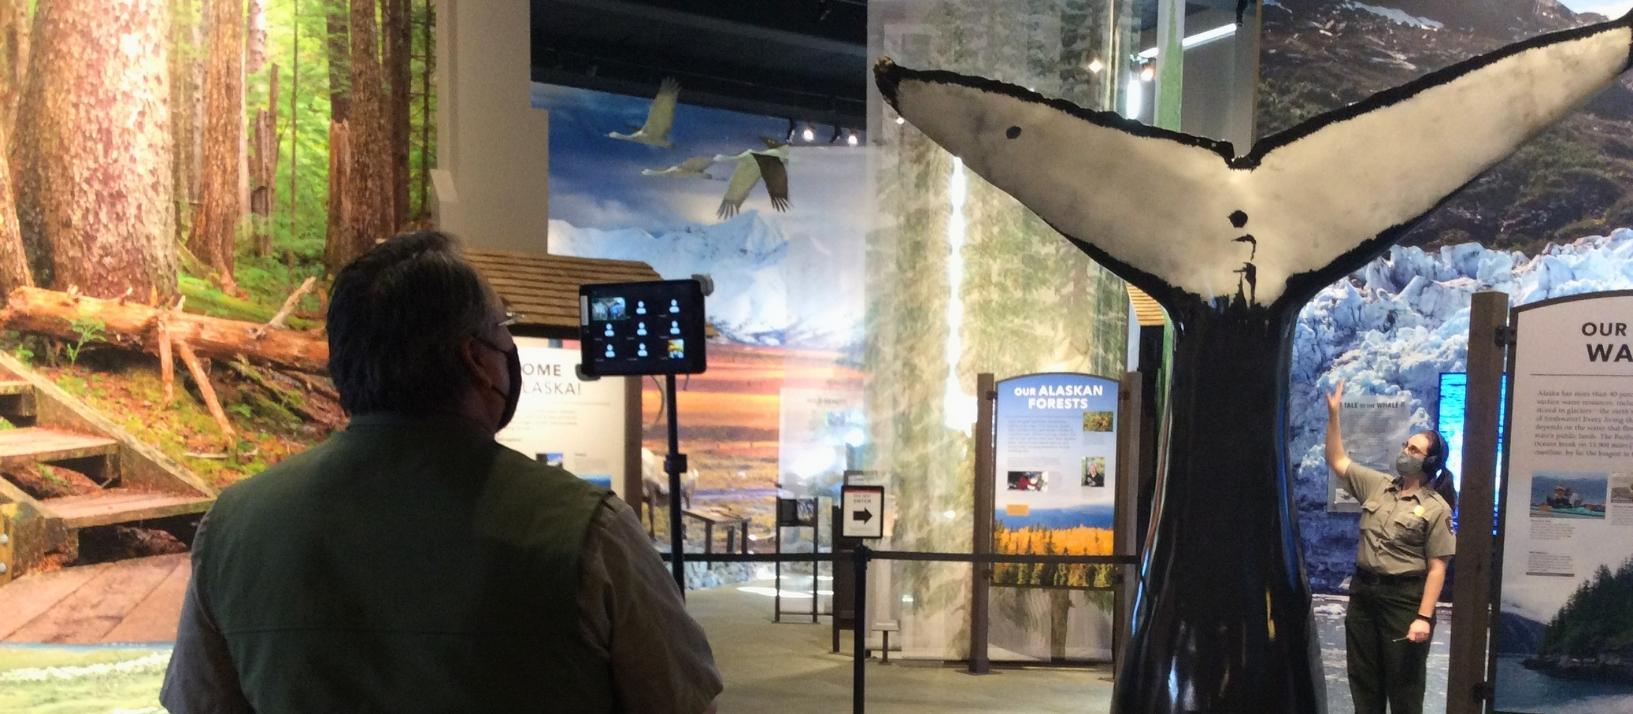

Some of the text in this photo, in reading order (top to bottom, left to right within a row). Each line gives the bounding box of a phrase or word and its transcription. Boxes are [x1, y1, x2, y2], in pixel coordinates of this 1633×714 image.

[1581, 322, 1627, 337] OUR
[1586, 343, 1633, 363] WA
[523, 382, 581, 395] LASKA!
[1014, 384, 1104, 397] OUR ALASKAN
[1028, 397, 1088, 410] FORESTS
